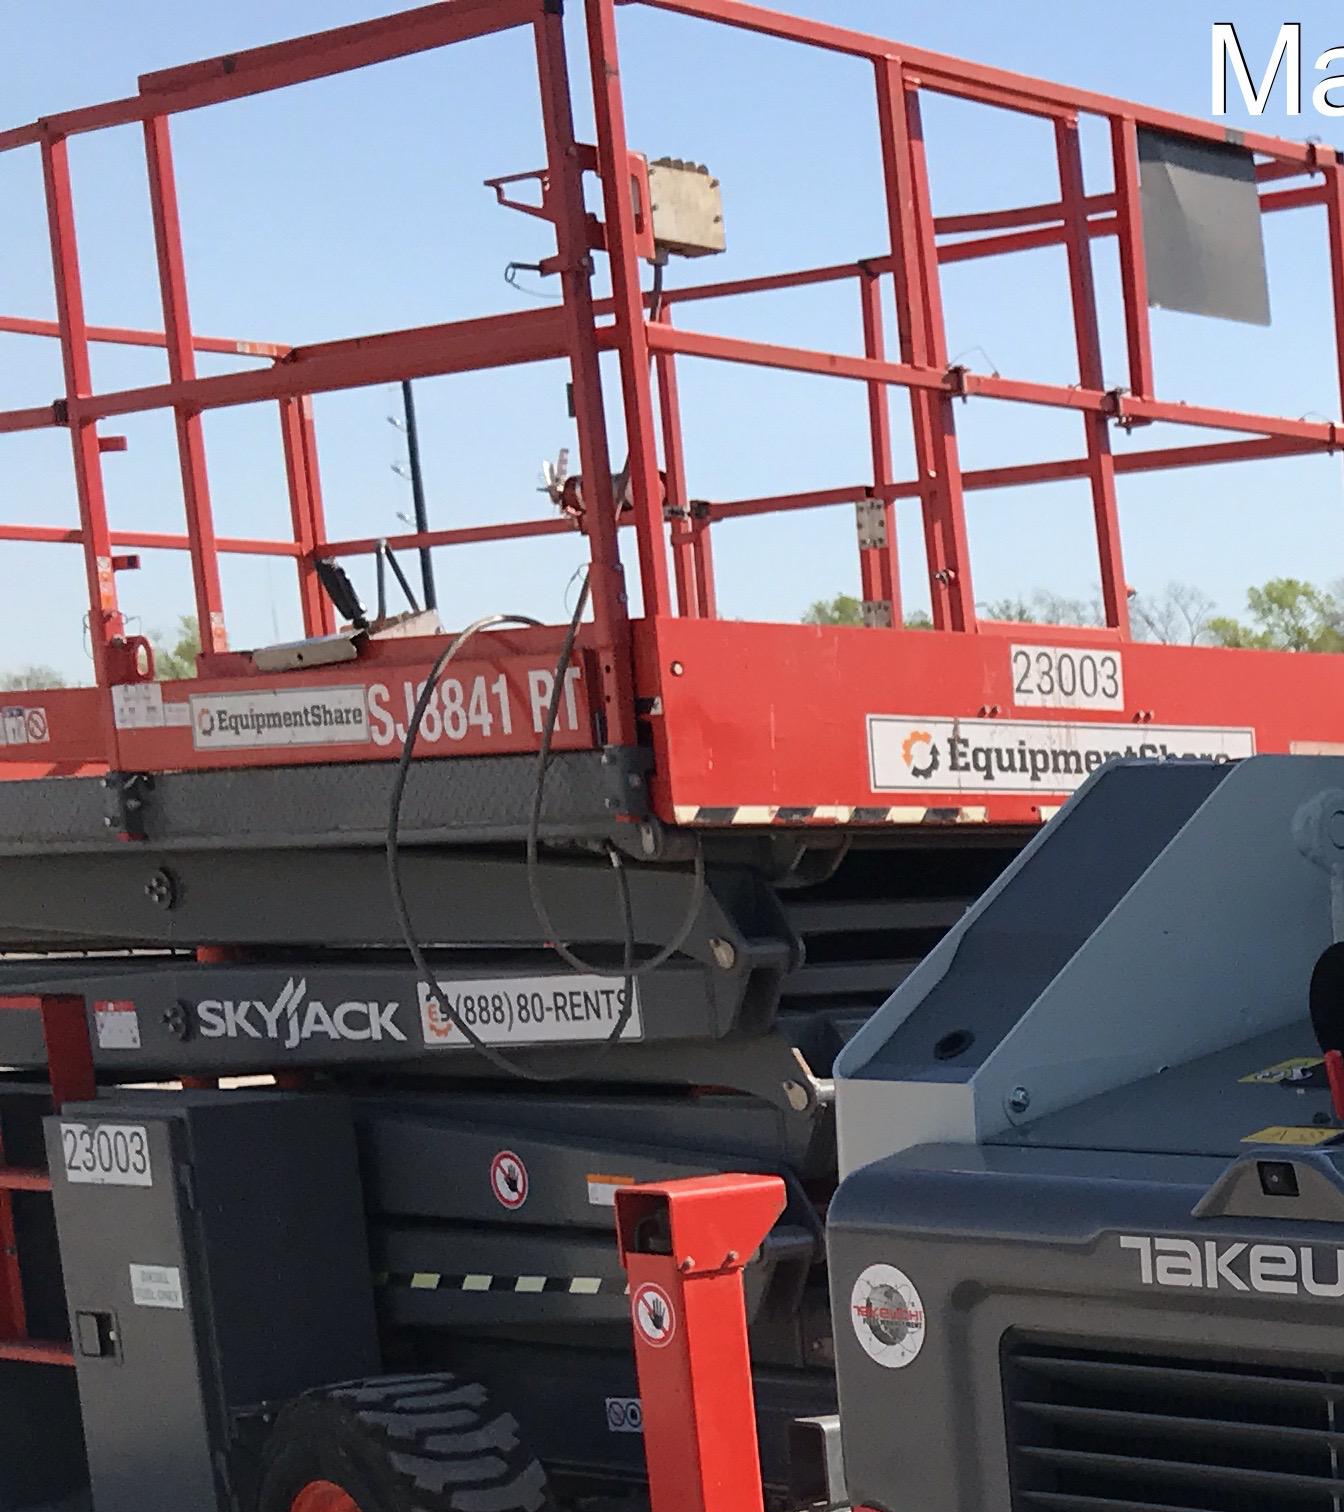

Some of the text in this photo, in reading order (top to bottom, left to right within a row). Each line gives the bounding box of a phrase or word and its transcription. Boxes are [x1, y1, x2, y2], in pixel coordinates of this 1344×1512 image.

[1012, 649, 1121, 700] 23003
[217, 703, 363, 735] EquipmentShare
[197, 976, 407, 1050] SKYJACK
[63, 1127, 148, 1175] 23003
